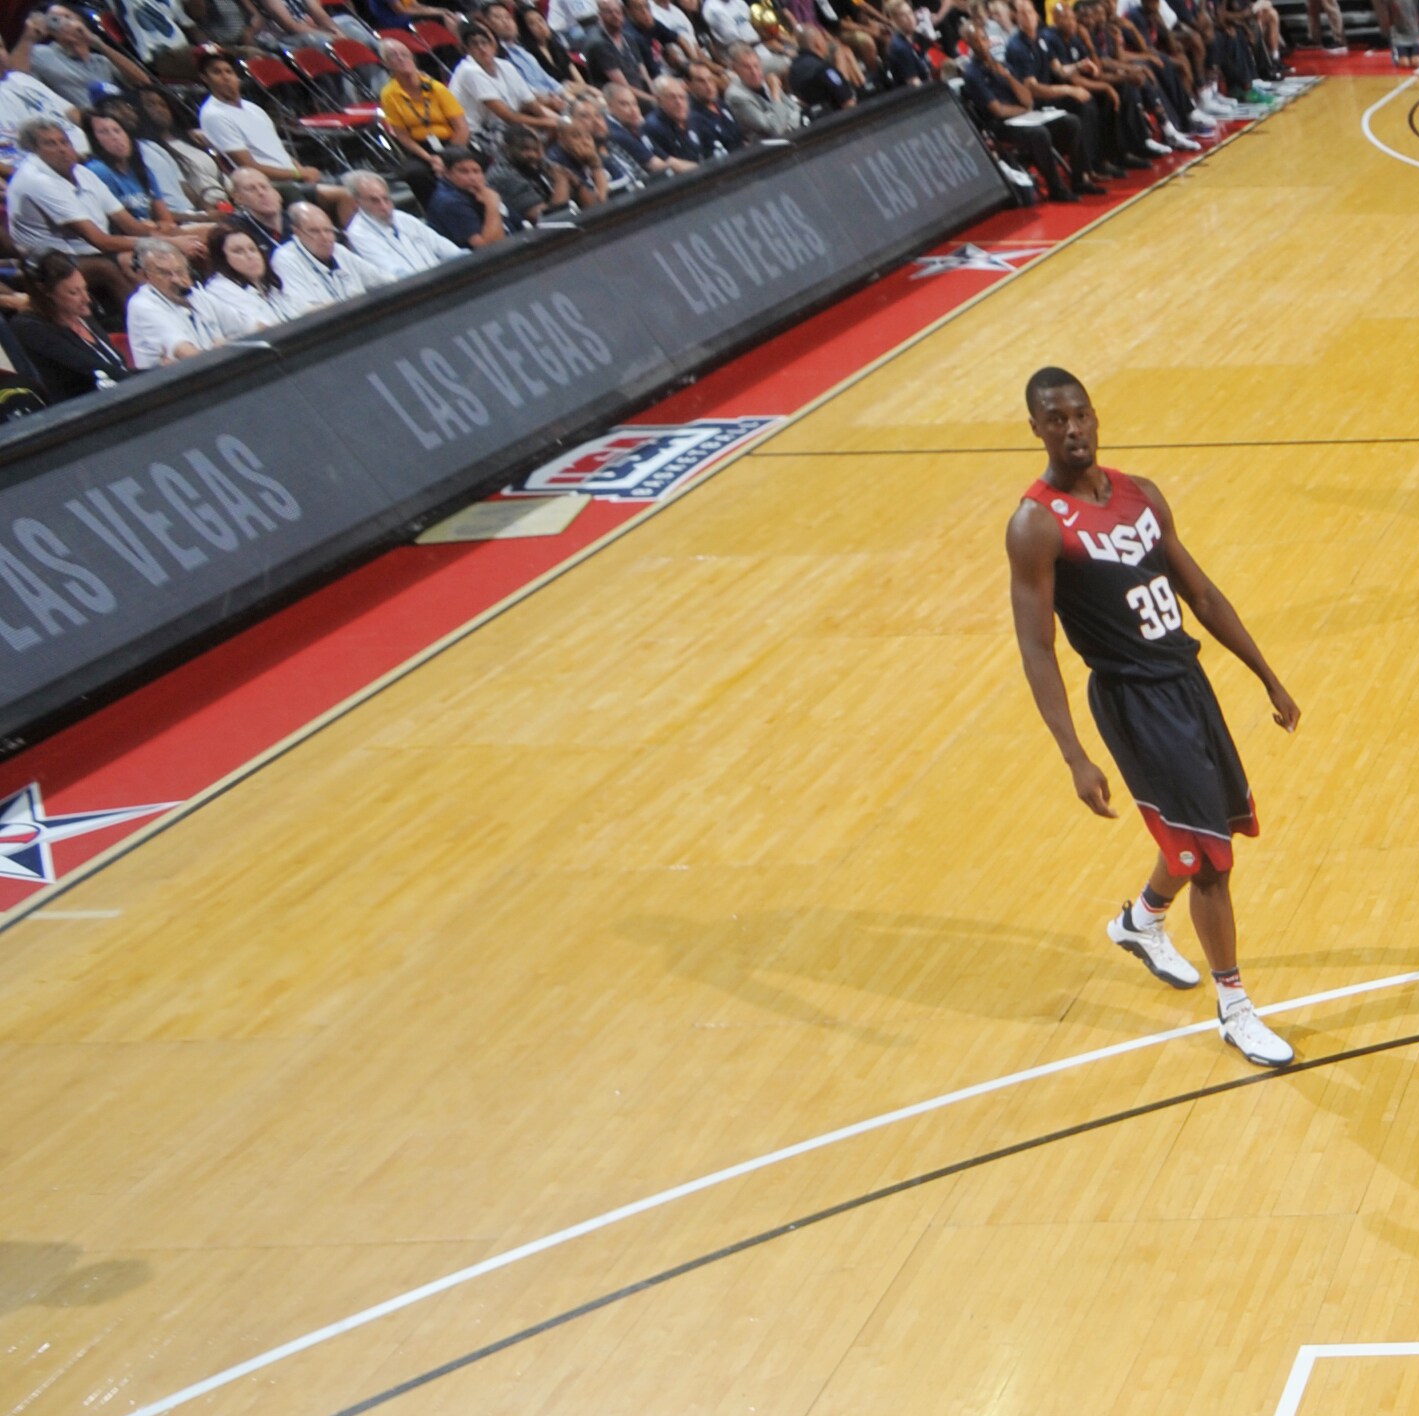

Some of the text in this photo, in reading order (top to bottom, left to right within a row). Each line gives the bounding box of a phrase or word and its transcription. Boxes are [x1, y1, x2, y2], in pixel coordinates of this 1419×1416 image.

[853, 124, 980, 221] LAS VEGAS
[653, 192, 827, 315] LAS VEGAS
[366, 291, 613, 451] LAS VEGAS
[544, 436, 692, 486] USA
[64, 433, 301, 587] VEGAS
[1077, 507, 1161, 566] USA
[1126, 575, 1181, 640] 39
